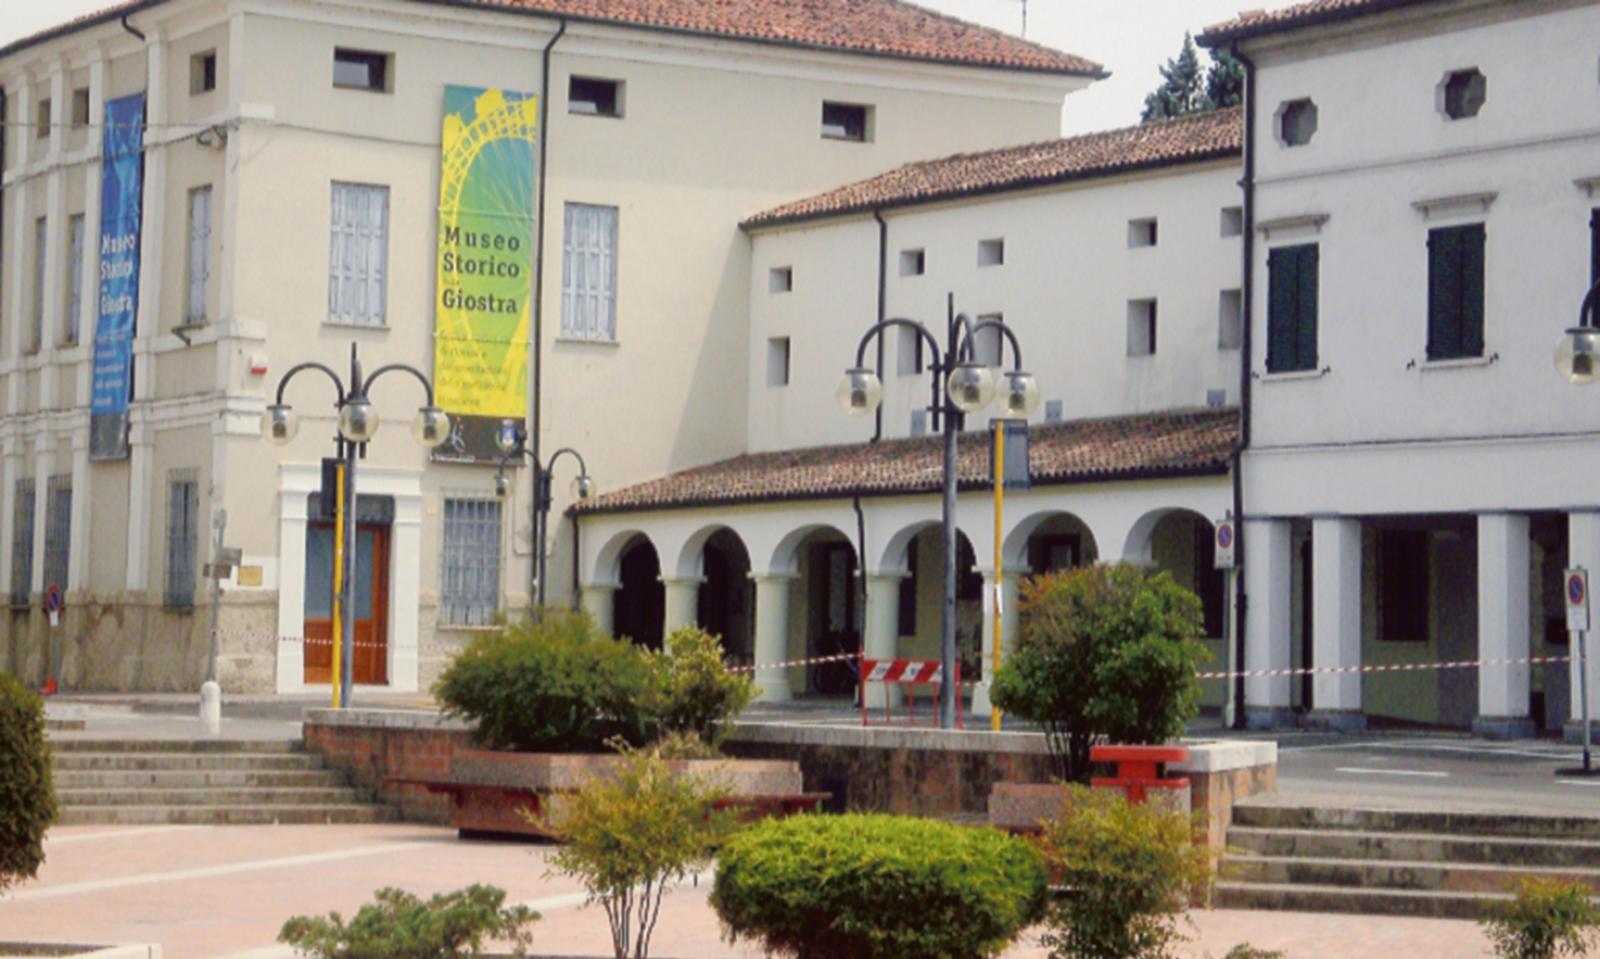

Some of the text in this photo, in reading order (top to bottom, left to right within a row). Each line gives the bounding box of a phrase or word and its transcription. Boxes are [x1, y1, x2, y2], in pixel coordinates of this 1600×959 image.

[444, 226, 520, 251] Museo
[443, 252, 520, 278] Storico
[442, 288, 517, 314] Giostra
